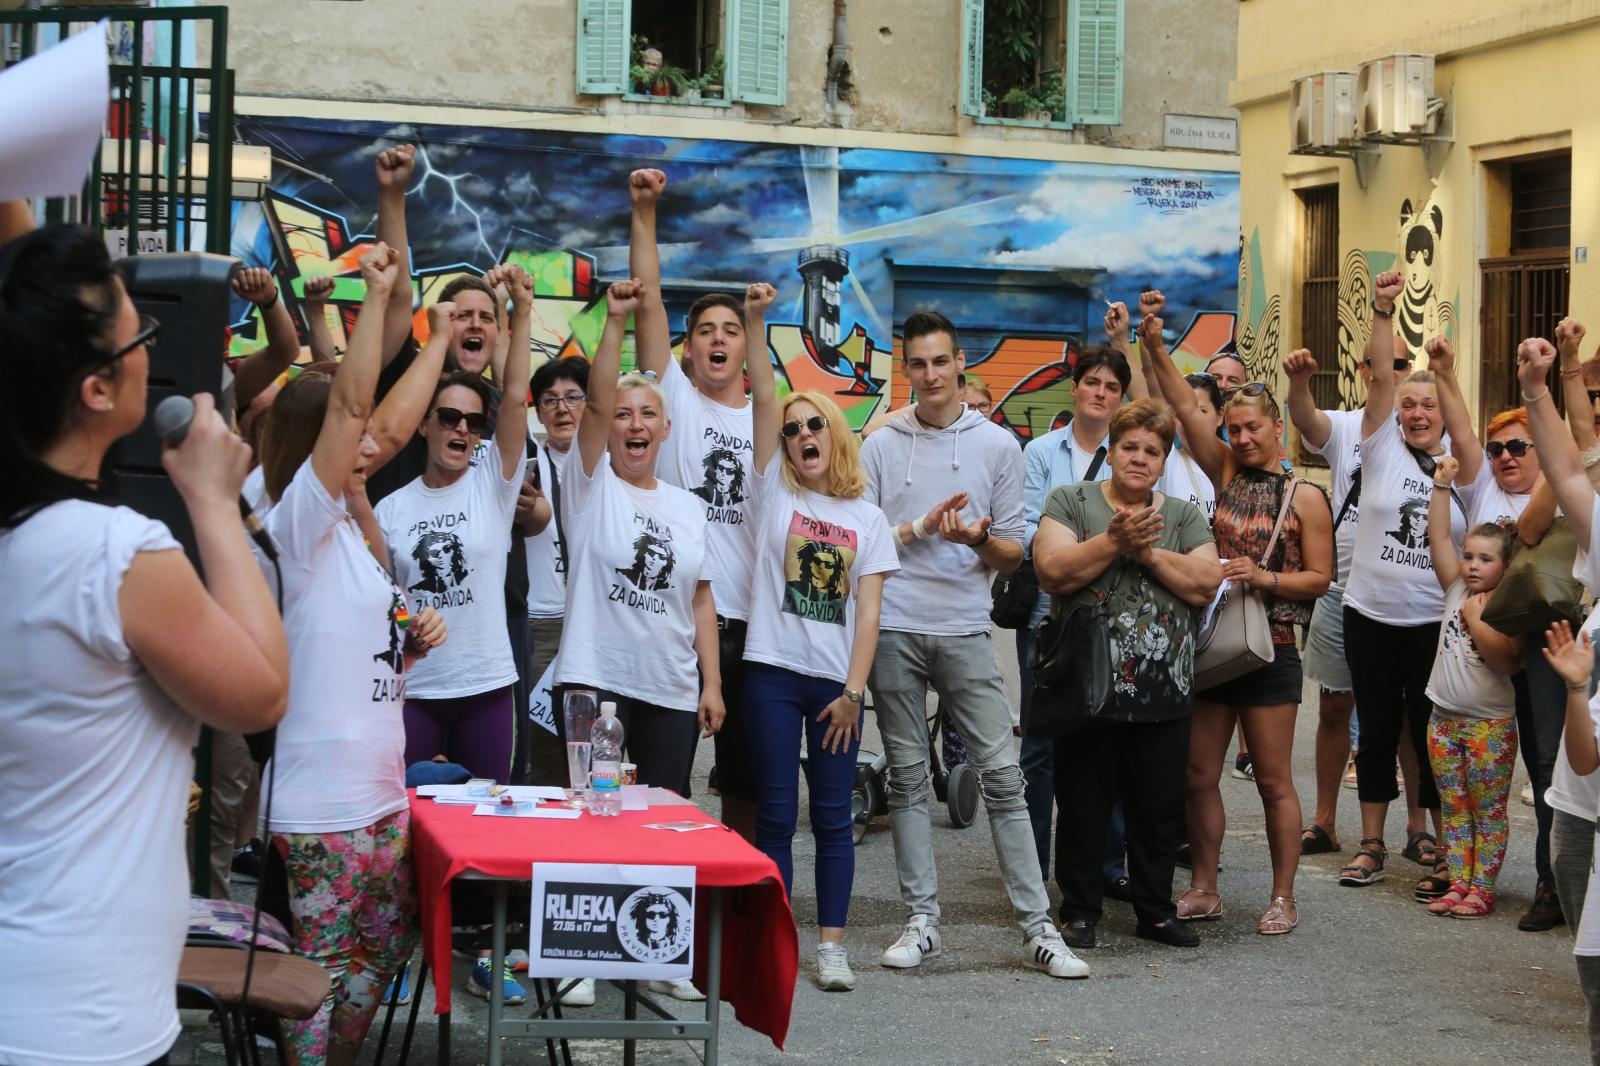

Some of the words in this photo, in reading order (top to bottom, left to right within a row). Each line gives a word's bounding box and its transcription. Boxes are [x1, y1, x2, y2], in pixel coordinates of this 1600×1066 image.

[1169, 126, 1203, 137] KRUŽNA
[1207, 130, 1231, 140] ULICA
[1147, 197, 1179, 208] RIJEKA
[118, 237, 164, 253] PAVDA
[704, 427, 754, 452] PRAVDA
[1403, 477, 1433, 496] PRAV
[706, 506, 745, 525] DAVIDA
[801, 516, 851, 542] PRAVDA
[1380, 545, 1394, 562] ZA
[1396, 550, 1435, 572] DAVIDA
[432, 587, 474, 610] DAVIDA
[608, 583, 626, 604] ZA
[627, 590, 669, 616] DAVIDA
[799, 599, 844, 623] DAVIDA
[372, 678, 389, 702] ZA
[529, 701, 547, 720] ZA
[545, 893, 617, 922] RIJEKA
[552, 920, 576, 932] 27.05
[583, 921, 592, 932] 17
[619, 924, 649, 959] PRAVDA
[670, 918, 692, 955] DAVIDA
